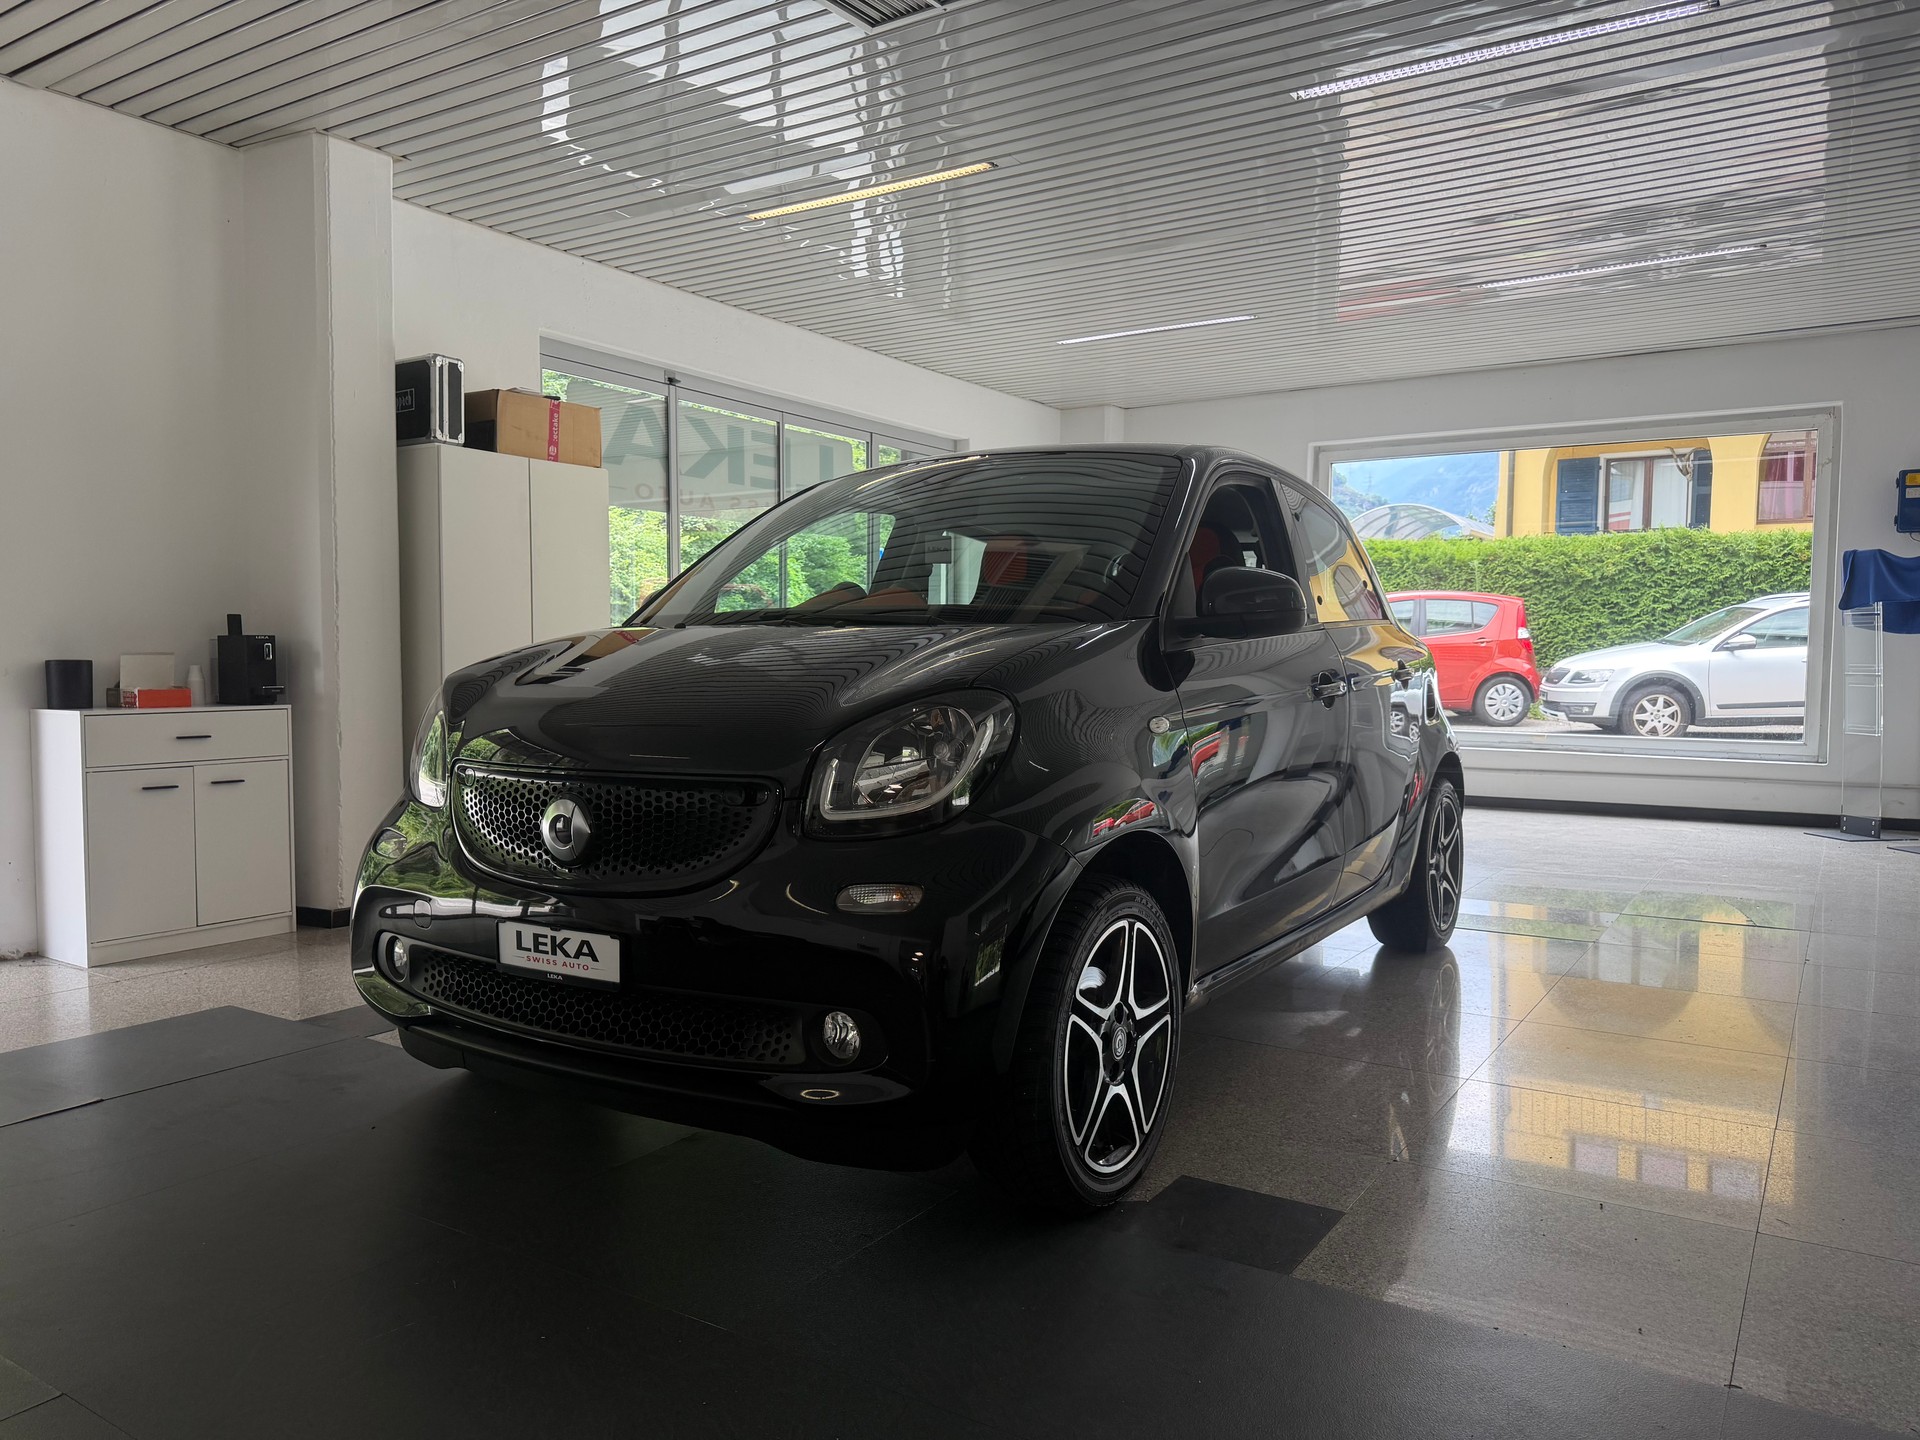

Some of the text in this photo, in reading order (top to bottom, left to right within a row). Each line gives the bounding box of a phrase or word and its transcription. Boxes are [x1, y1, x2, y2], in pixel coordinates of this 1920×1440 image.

[515, 930, 599, 962] LEKA
[526, 955, 589, 970] SWISS AUTO
[547, 973, 563, 981] LEKA
